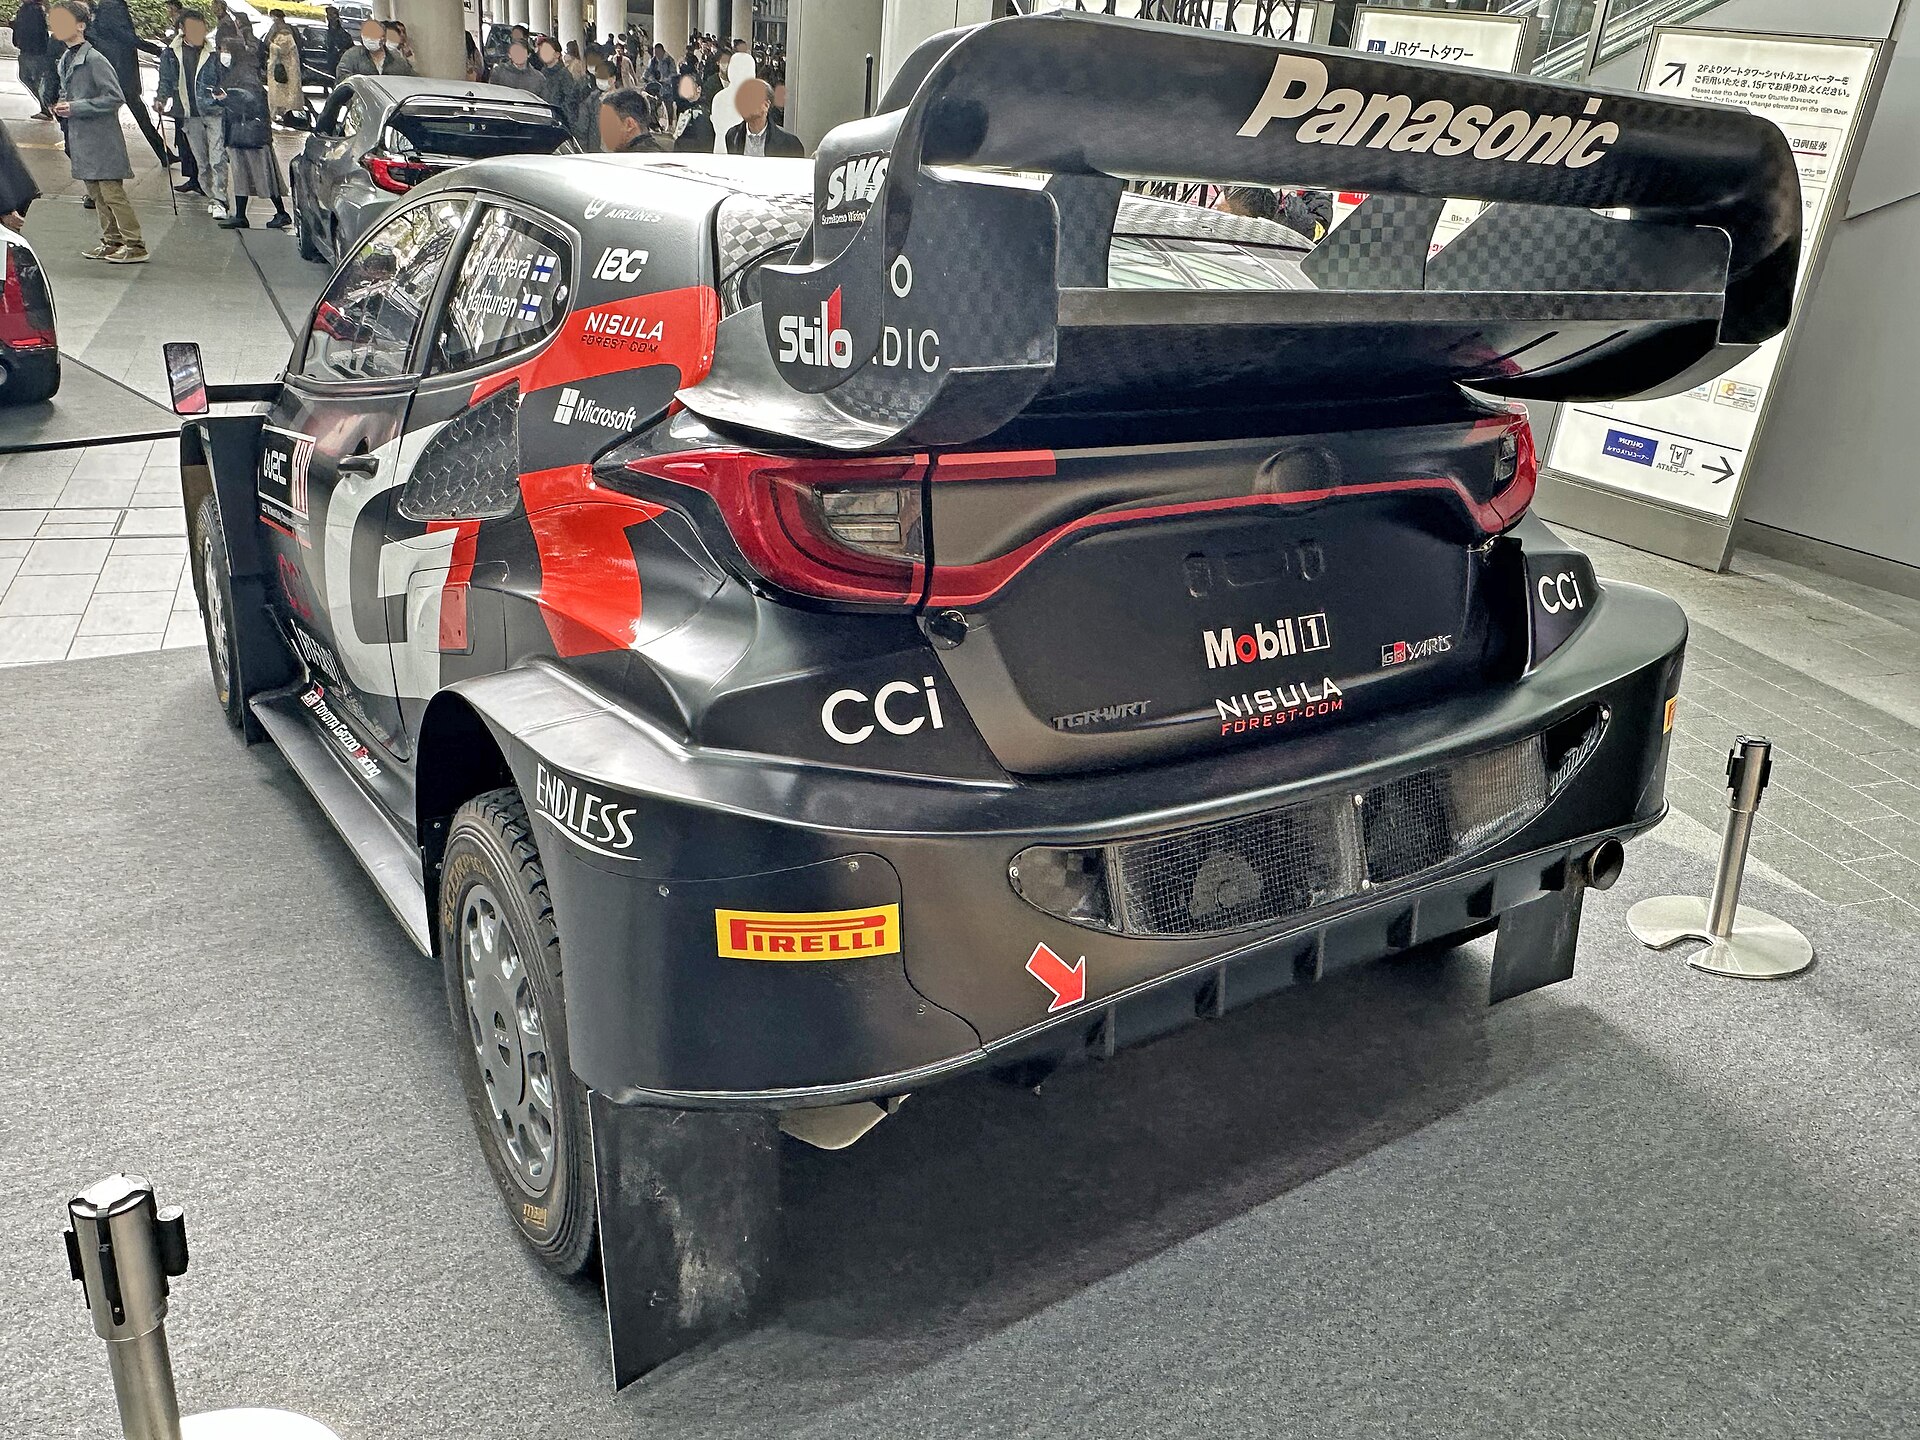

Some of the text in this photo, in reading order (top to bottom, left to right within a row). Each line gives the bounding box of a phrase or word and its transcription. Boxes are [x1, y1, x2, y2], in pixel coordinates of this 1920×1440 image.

[1390, 41, 1474, 61] JRゲートタワー
[1236, 53, 1620, 168] Panasonic
[605, 208, 664, 223] AIRLINES
[584, 312, 664, 341] NISULA
[778, 298, 853, 369] Stilo
[872, 326, 940, 373] DIC
[574, 398, 637, 433] Microsoft
[1202, 618, 1297, 669] Mobil
[313, 699, 340, 730] TOYOTA
[1215, 677, 1343, 720] NISULA
[536, 762, 637, 849] ENDLESS
[730, 914, 887, 953] PIRELLI
